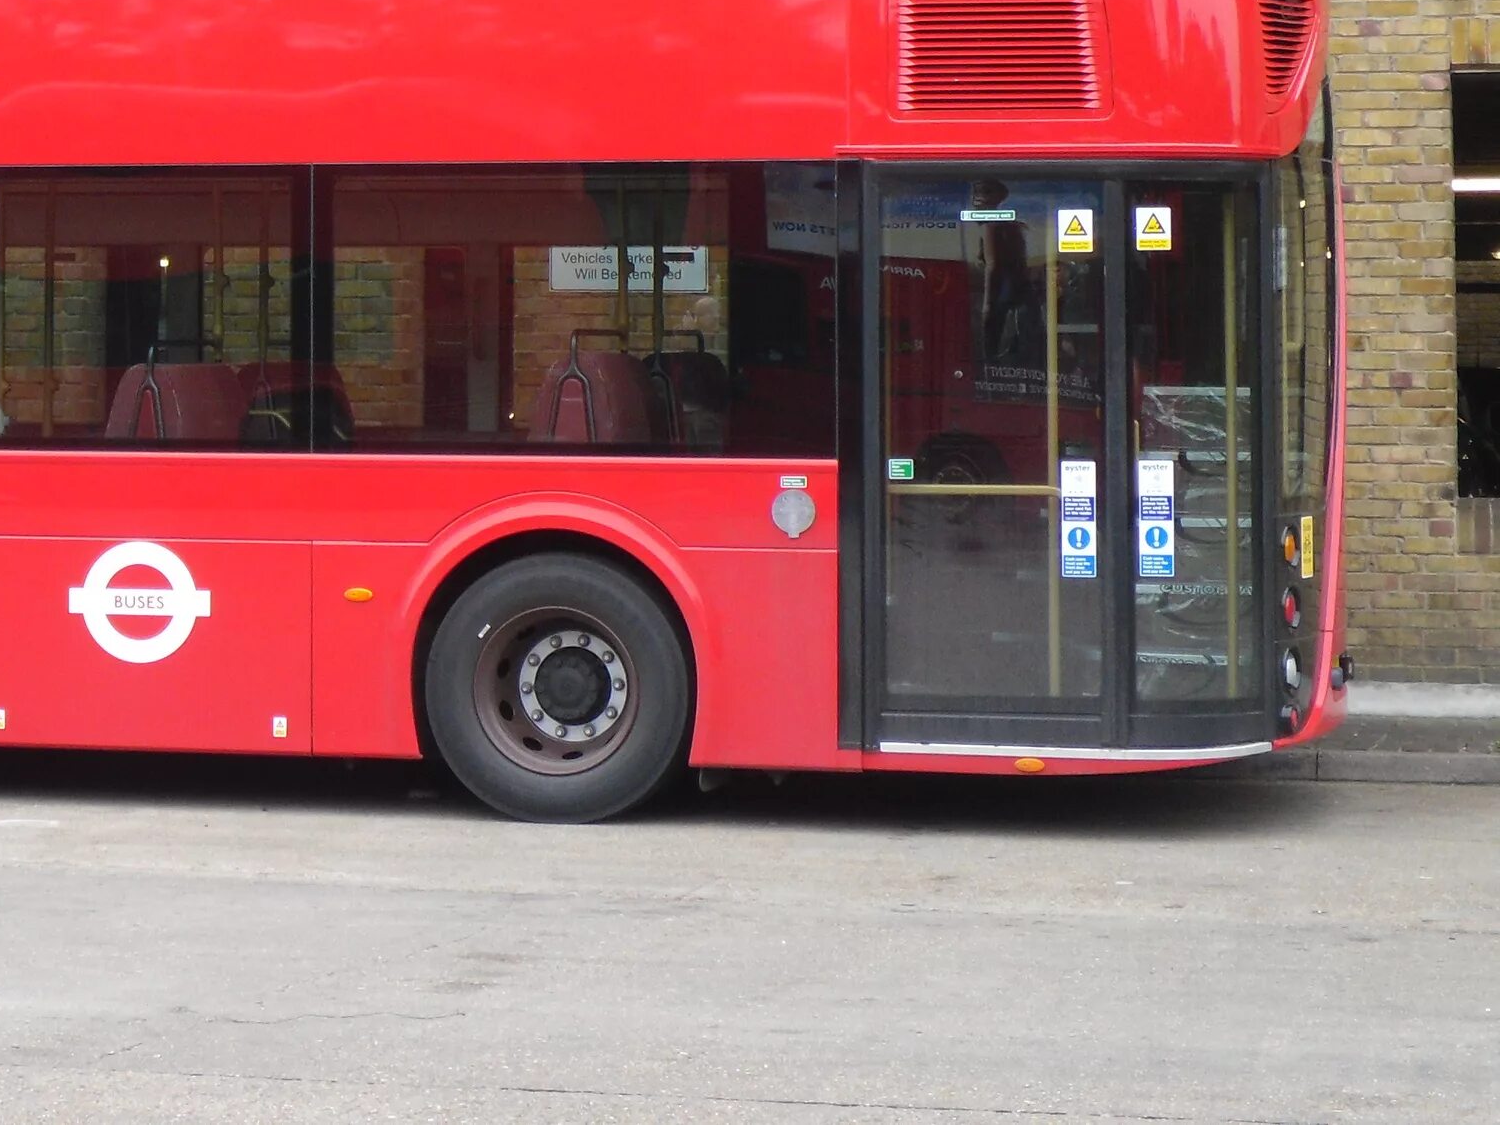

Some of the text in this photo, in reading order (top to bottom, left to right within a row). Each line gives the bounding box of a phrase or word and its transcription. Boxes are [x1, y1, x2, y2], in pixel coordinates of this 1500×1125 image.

[561, 252, 613, 264] Vehicles
[575, 268, 597, 280] Will
[601, 269, 618, 280] Be
[114, 595, 164, 609] BUSES
